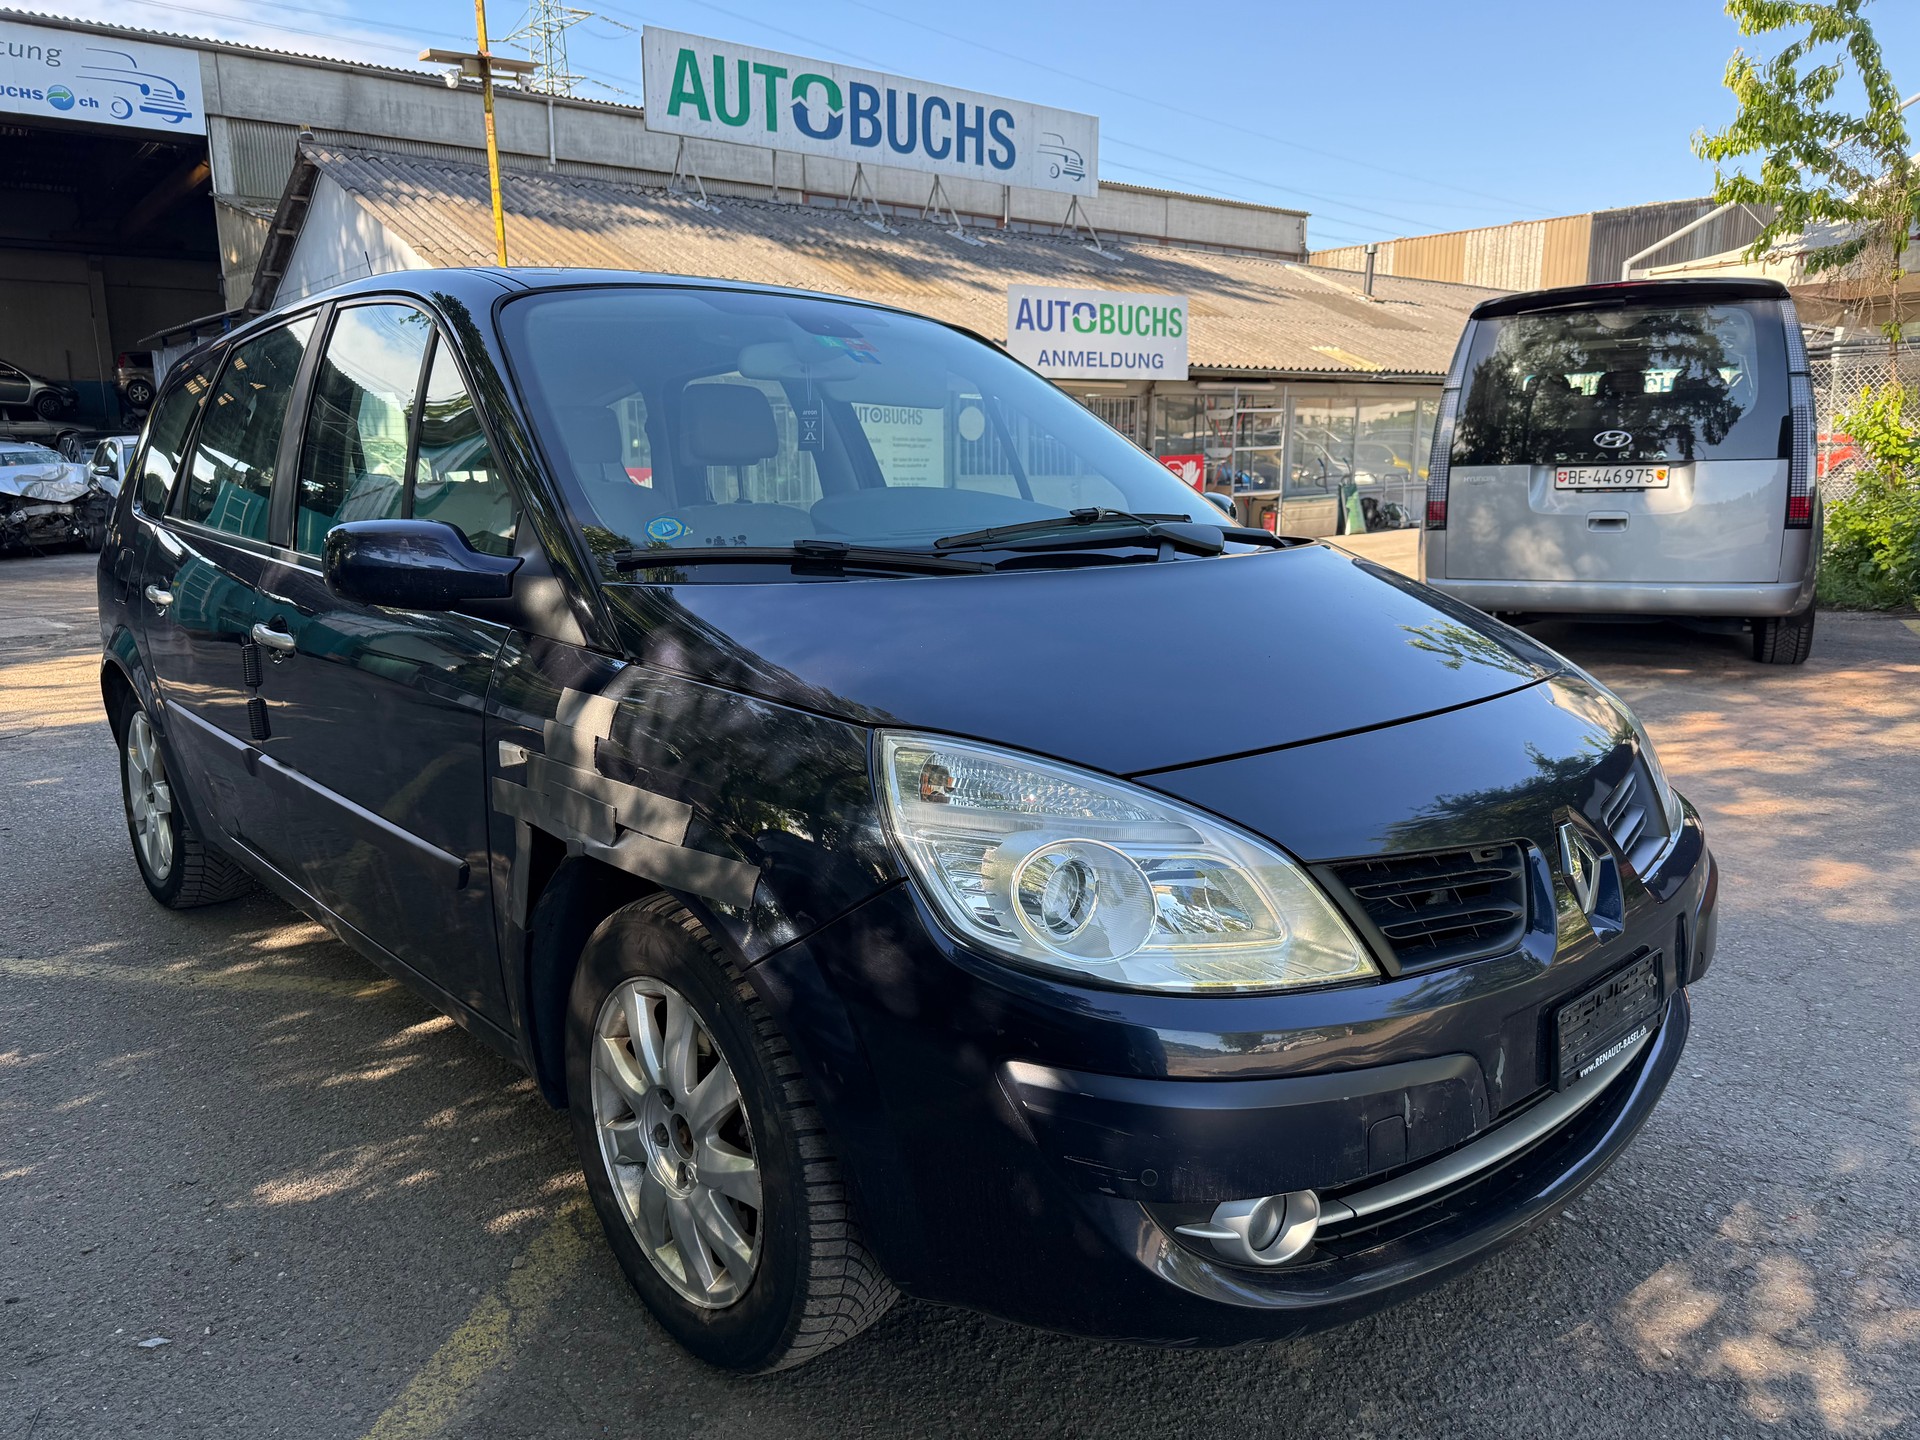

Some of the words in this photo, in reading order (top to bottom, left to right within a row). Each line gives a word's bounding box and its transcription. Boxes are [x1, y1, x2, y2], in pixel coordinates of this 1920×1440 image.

[667, 48, 1016, 170] AUTOBUCHS
[1015, 298, 1183, 338] AUTOBUCHS
[1037, 349, 1164, 369] ANMELDUNG
[854, 407, 923, 425] UTOBUCHS
